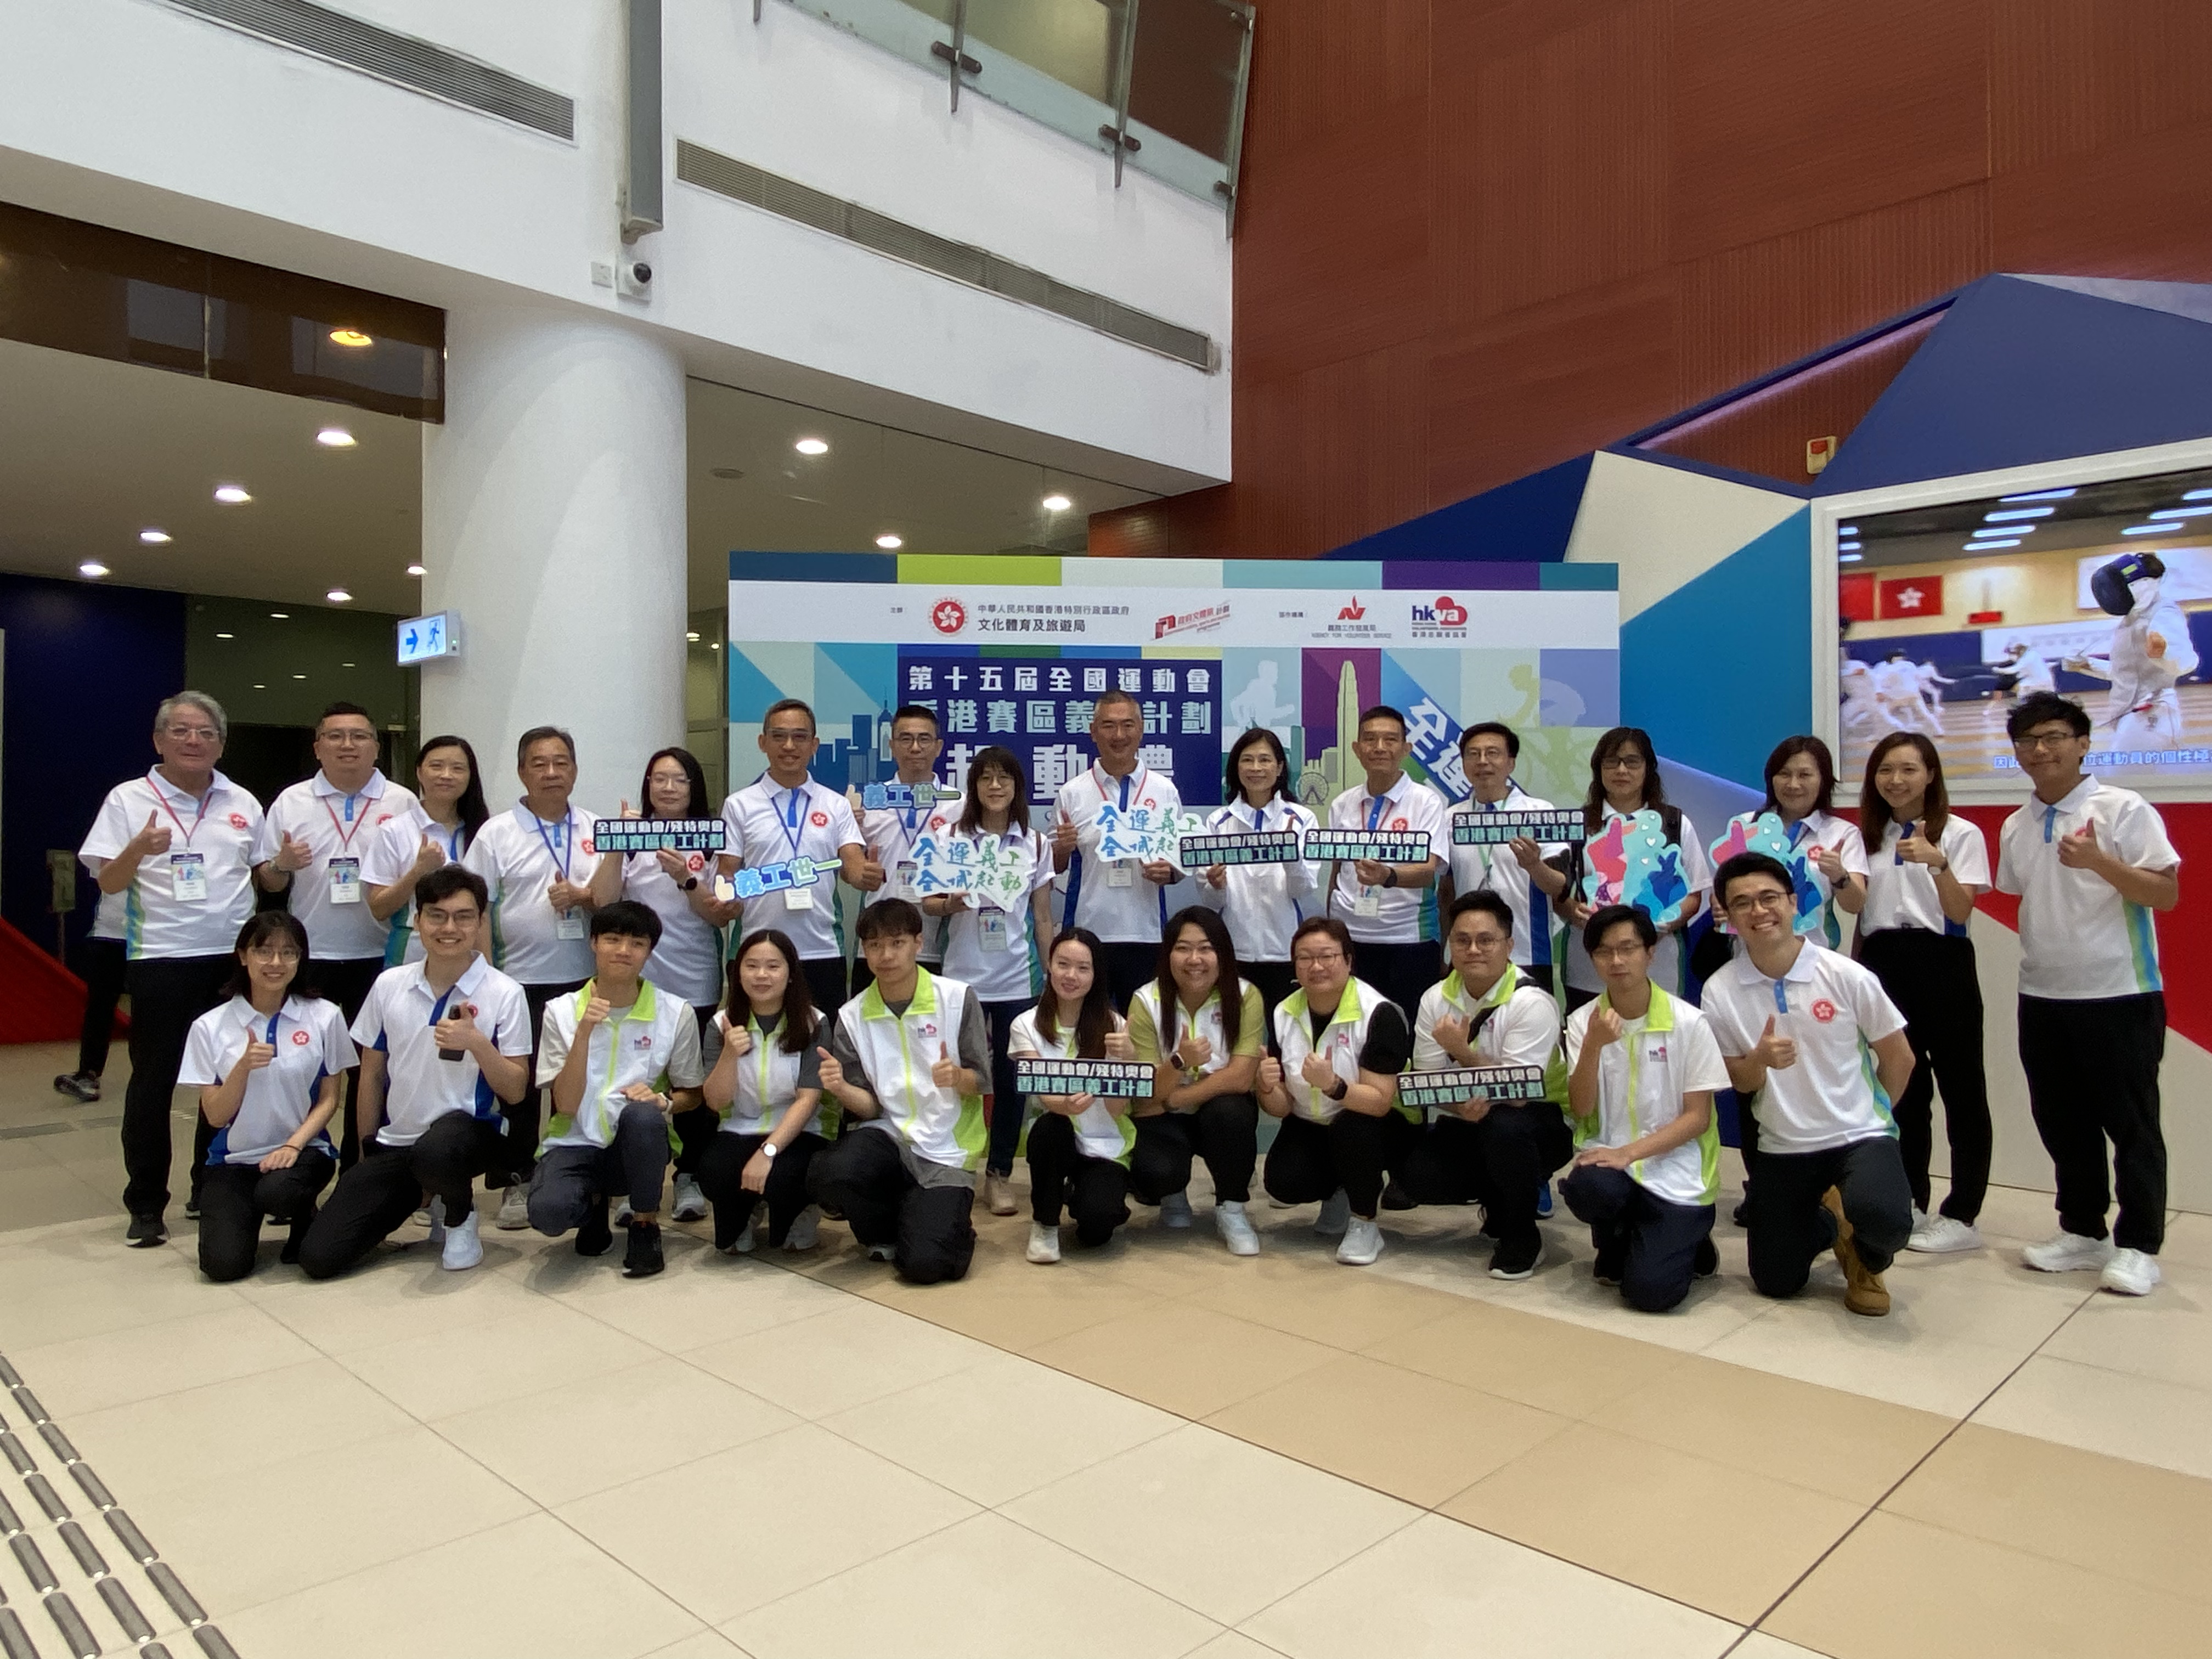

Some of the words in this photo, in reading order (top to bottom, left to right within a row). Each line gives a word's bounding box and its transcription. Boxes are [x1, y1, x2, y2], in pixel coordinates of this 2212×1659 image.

[978, 605, 1130, 615] 中華人民共和國香港特別行政區政府
[978, 618, 1086, 632] 文化體育及旅遊局
[909, 666, 1210, 693] 第十五屆全國運動會
[864, 783, 961, 808] 義工世一
[913, 838, 1023, 872] 全運義工
[735, 857, 842, 898] 義工世一
